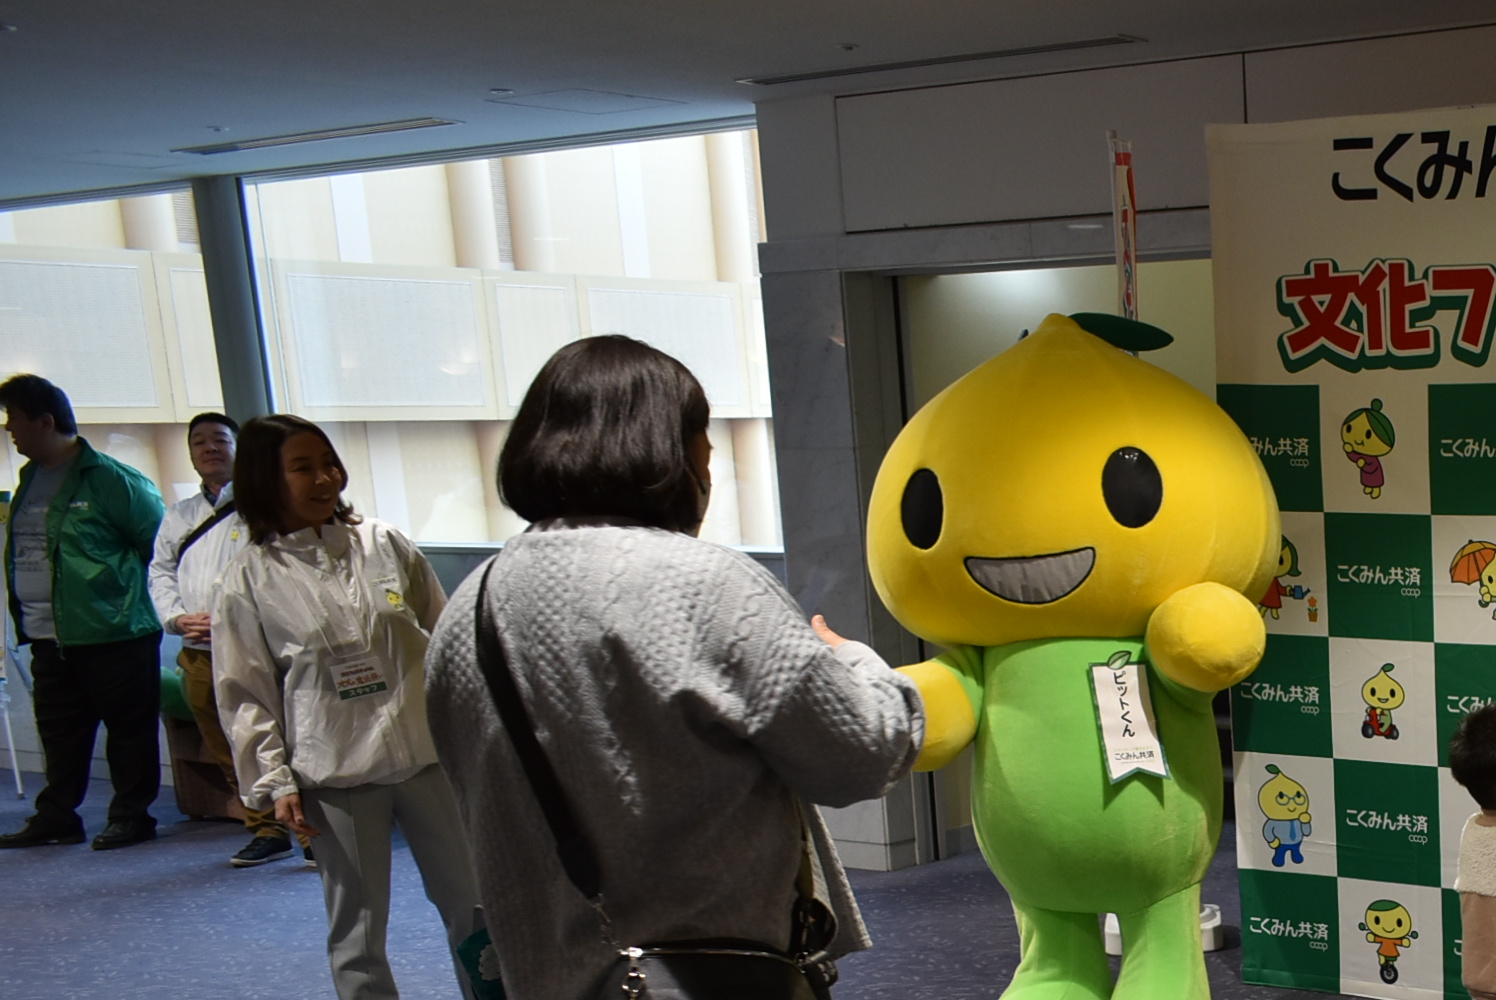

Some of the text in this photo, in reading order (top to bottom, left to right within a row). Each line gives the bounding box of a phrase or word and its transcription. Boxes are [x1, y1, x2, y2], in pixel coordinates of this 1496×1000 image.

[1249, 437, 1309, 456] みん共済
[1337, 565, 1421, 586] こくみん共済
[1113, 670, 1136, 738] ピットくん
[1240, 682, 1319, 705] こくみん共済
[1346, 809, 1428, 833] こくみん共済
[1250, 917, 1328, 940] こくみん共済
